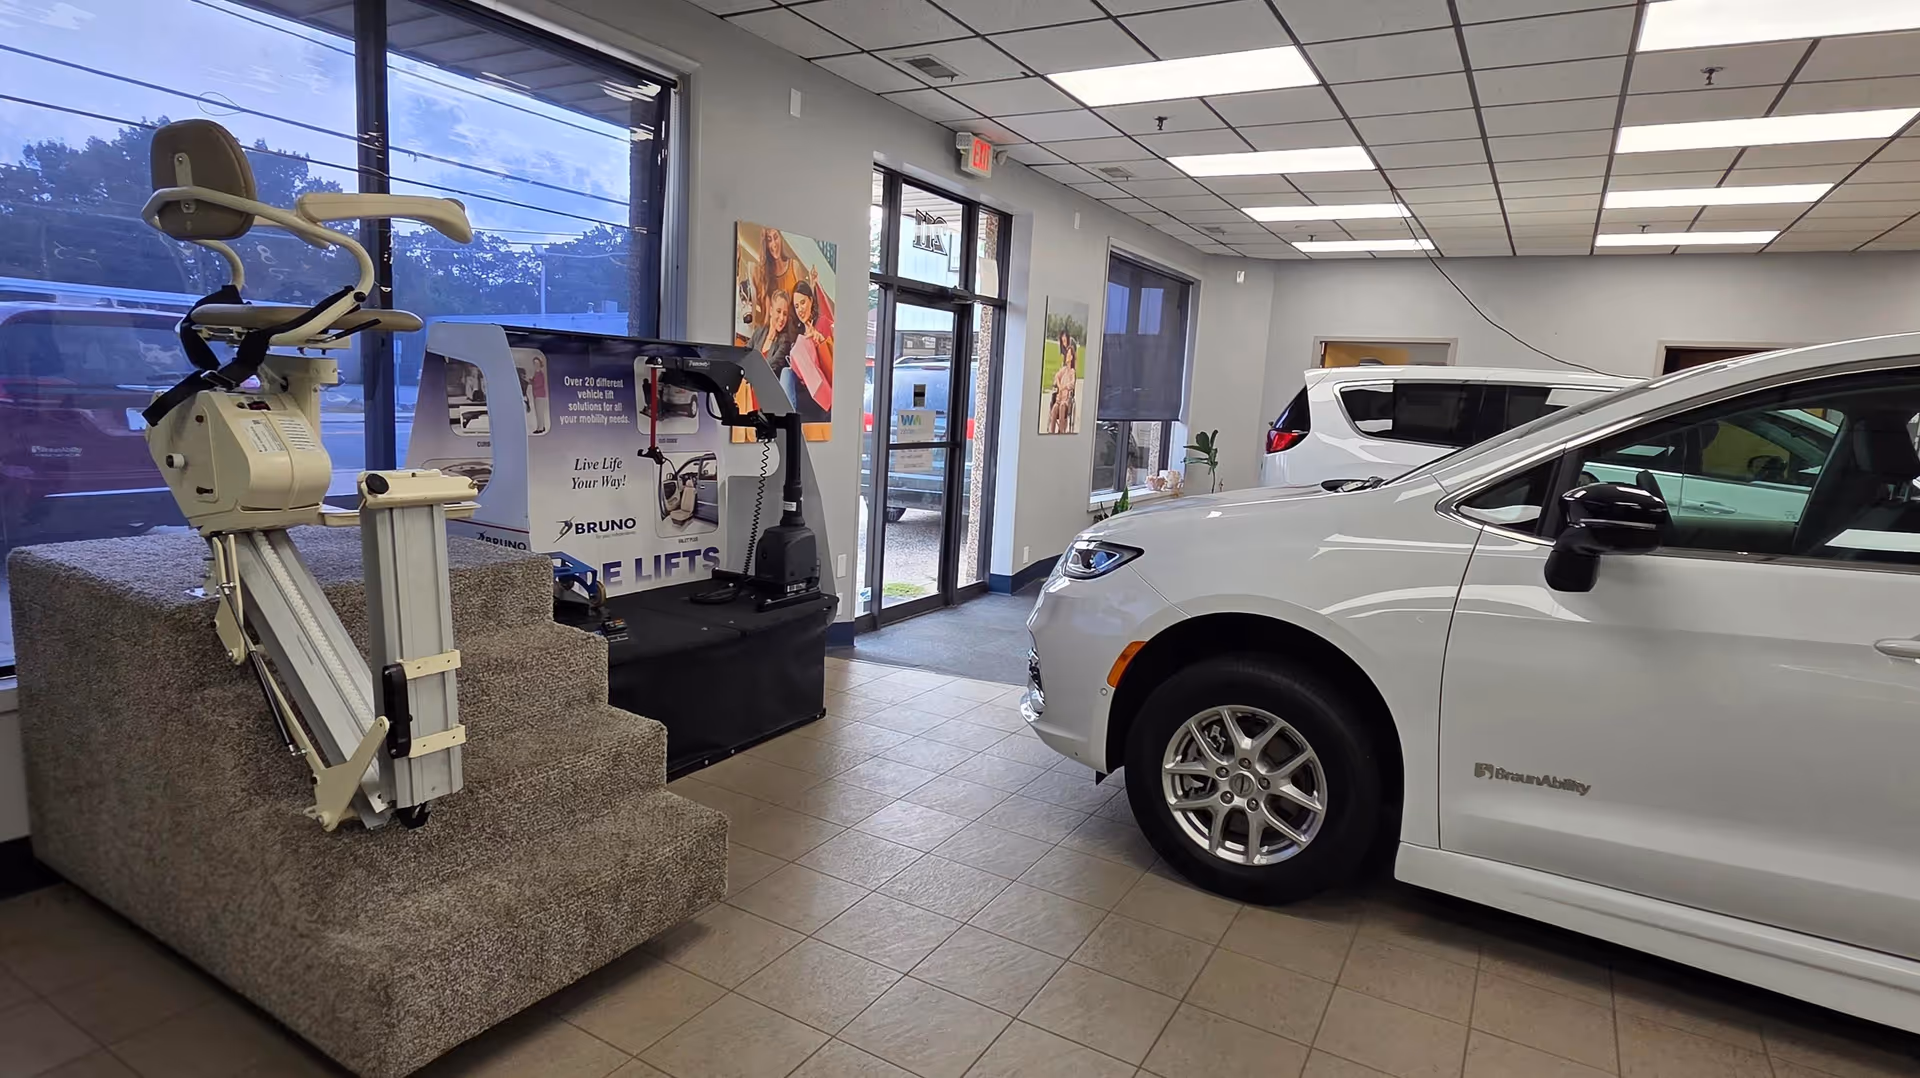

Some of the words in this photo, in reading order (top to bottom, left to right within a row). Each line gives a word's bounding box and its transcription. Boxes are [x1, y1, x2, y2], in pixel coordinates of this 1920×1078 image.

[972, 138, 991, 171] EXIT
[564, 376, 583, 386] Over
[585, 377, 595, 387] 20
[596, 377, 624, 388] different
[577, 389, 604, 399] vehicle
[604, 389, 614, 399] lift
[568, 401, 602, 411] solutions
[603, 401, 613, 411] for
[614, 402, 623, 412] all
[560, 415, 577, 425] your
[579, 413, 608, 426] mobility
[609, 414, 630, 424] needs.
[574, 458, 599, 471] Live
[602, 457, 623, 472] Life
[571, 477, 598, 490] Your
[601, 474, 627, 490] Way!
[574, 517, 637, 535] BRUNO
[634, 547, 720, 584] LIFTS
[1494, 766, 1592, 797] BraunAbility
